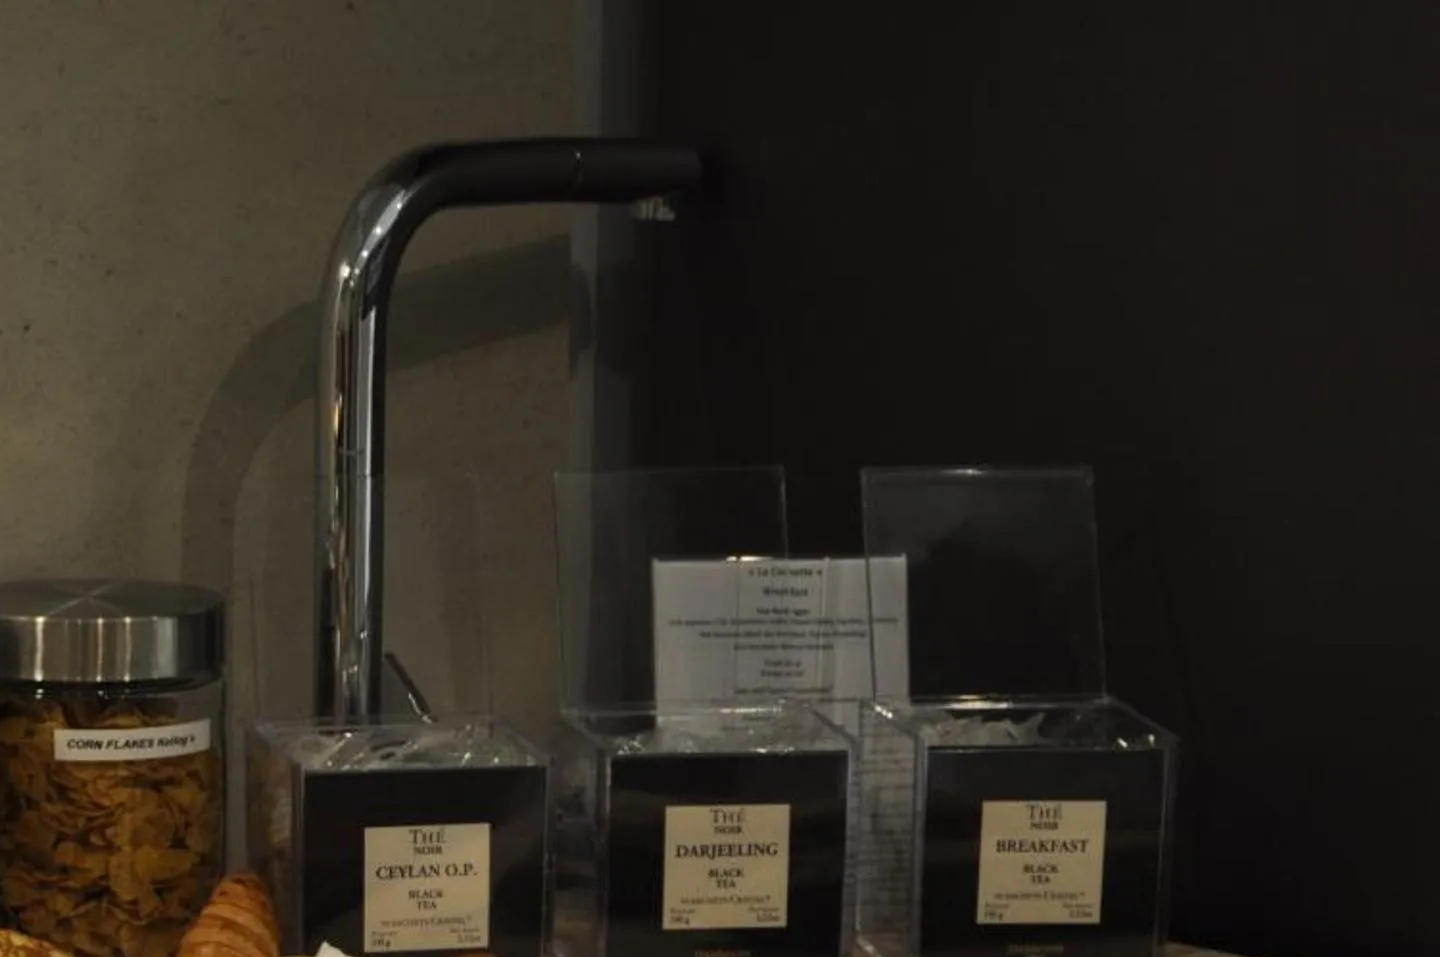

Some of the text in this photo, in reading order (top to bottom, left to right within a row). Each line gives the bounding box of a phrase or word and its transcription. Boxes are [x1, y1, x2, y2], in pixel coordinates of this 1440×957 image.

[67, 738, 103, 751] CORN
[105, 737, 154, 751] FLAKES
[676, 843, 778, 860] DARJEELING
[995, 839, 1090, 854] BREAKFAST
[375, 862, 478, 880] CEYLAN O.P.
